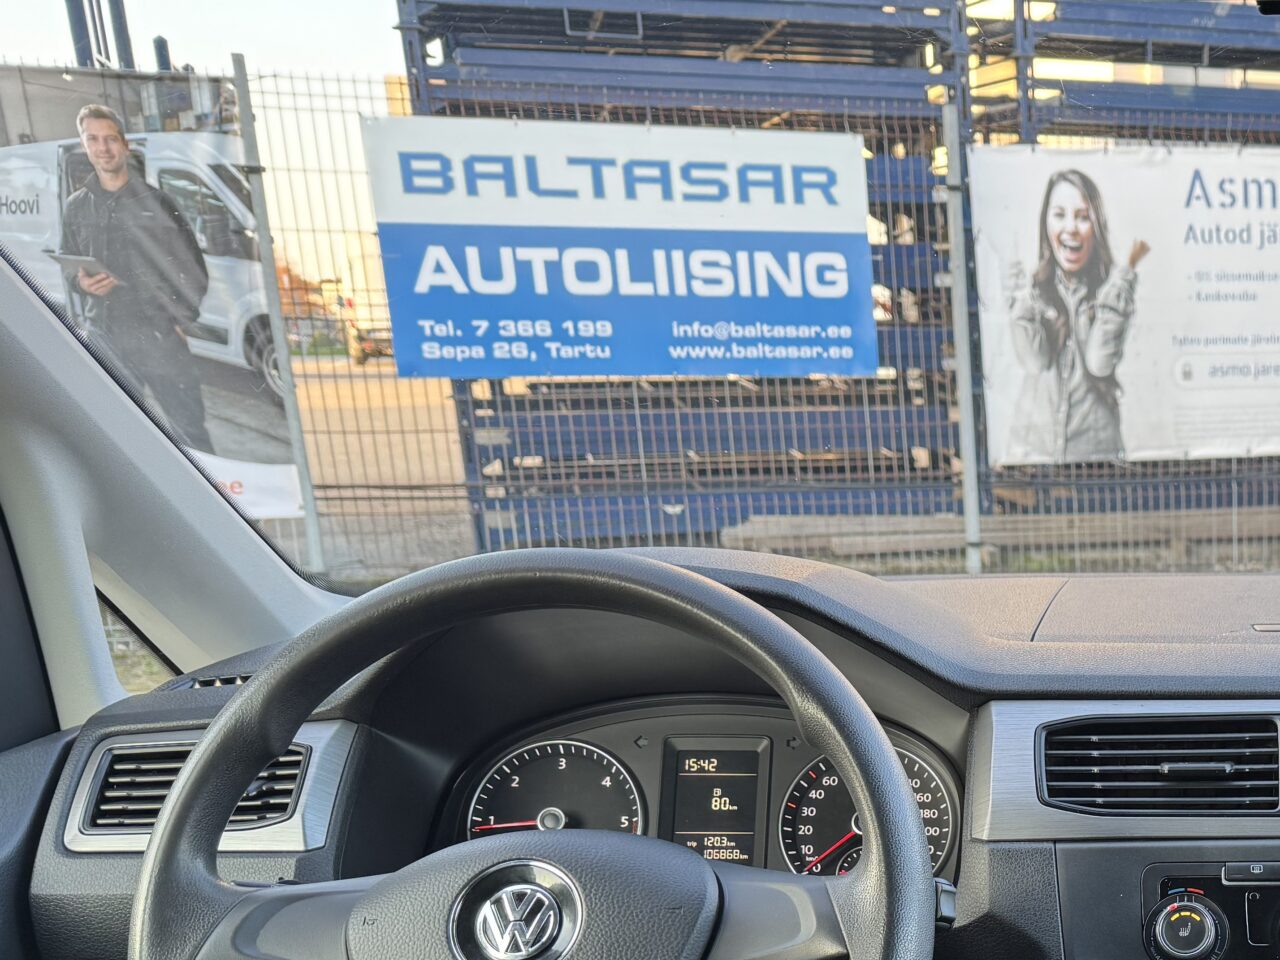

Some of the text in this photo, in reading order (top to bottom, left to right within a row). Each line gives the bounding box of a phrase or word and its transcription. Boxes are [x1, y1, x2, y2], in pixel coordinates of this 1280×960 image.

[398, 151, 839, 206] BALTASAR
[1184, 222, 1251, 245] Autod
[413, 244, 849, 299] AUTOLIISING
[417, 319, 613, 337] Tel. 7 366 199
[671, 320, 853, 341] info@baltasar.ee
[421, 341, 612, 362] Sepa 26, Tartu
[668, 342, 854, 360] www.baltasar.ee
[558, 758, 567, 770] 3
[684, 758, 718, 771] 15:42
[511, 776, 520, 788] 2
[601, 776, 612, 788] 4
[822, 776, 839, 786] 60
[808, 789, 825, 799] 40
[801, 806, 817, 816] 30
[620, 816, 630, 828] 5
[798, 824, 813, 835] 20
[924, 826, 940, 836] 00
[686, 840, 697, 848] trip
[800, 844, 814, 855] 10
